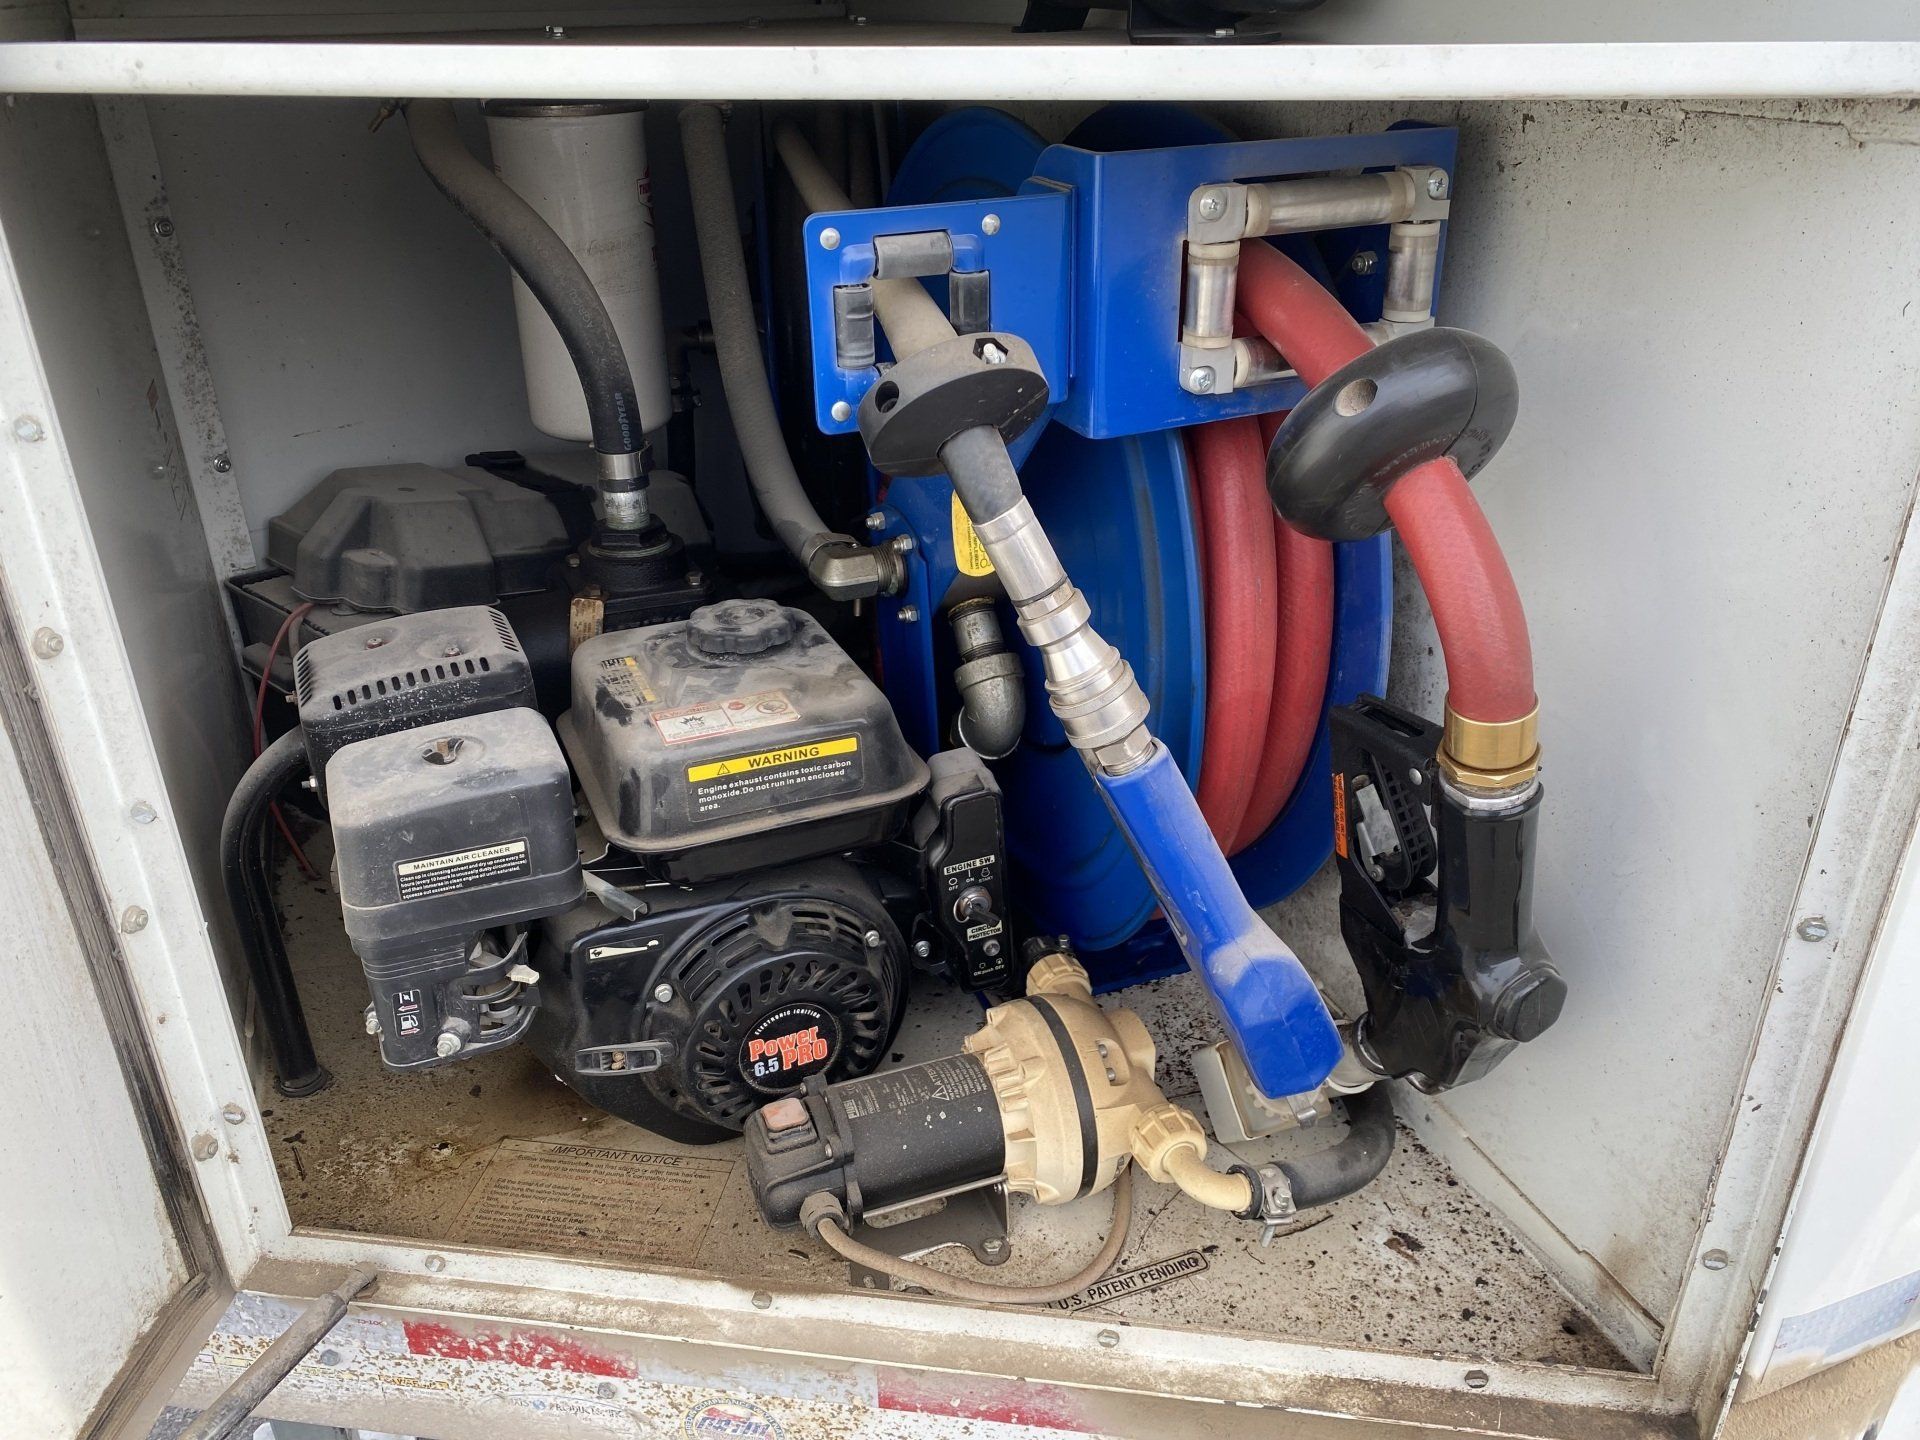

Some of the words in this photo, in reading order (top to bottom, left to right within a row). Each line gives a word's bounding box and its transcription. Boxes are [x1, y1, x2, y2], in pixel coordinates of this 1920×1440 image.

[615, 392, 632, 450] GOODYEAR
[748, 746, 819, 768] WARNING
[697, 783, 727, 796] Engine
[729, 776, 762, 789] exhaust
[763, 769, 798, 782] contains
[801, 764, 821, 774] toxic
[823, 759, 851, 770] carbon
[755, 783, 769, 792] not
[771, 780, 784, 789] run
[786, 778, 794, 786] in
[796, 776, 806, 784] an
[807, 768, 844, 782] enclosed
[699, 802, 720, 811] area.
[413, 857, 453, 870] MAINTAIN
[455, 854, 469, 862] AIR
[471, 846, 510, 858] CLEANER
[946, 861, 977, 874] ENGINE
[979, 856, 994, 865] SW.
[969, 928, 1001, 940] PROTECTOR
[754, 1010, 791, 1035] ELECTRONIC
[793, 1008, 821, 1019] IGNITION
[748, 1026, 819, 1062] Power
[782, 1038, 828, 1071] PRO
[754, 1057, 779, 1077] 6.5
[551, 1145, 630, 1160] IMPORTANT
[631, 1153, 683, 1166] NOTICE
[1058, 1293, 1087, 1310] U.S.
[1087, 1276, 1137, 1301] PATENT
[1139, 1256, 1200, 1282] PENDING
